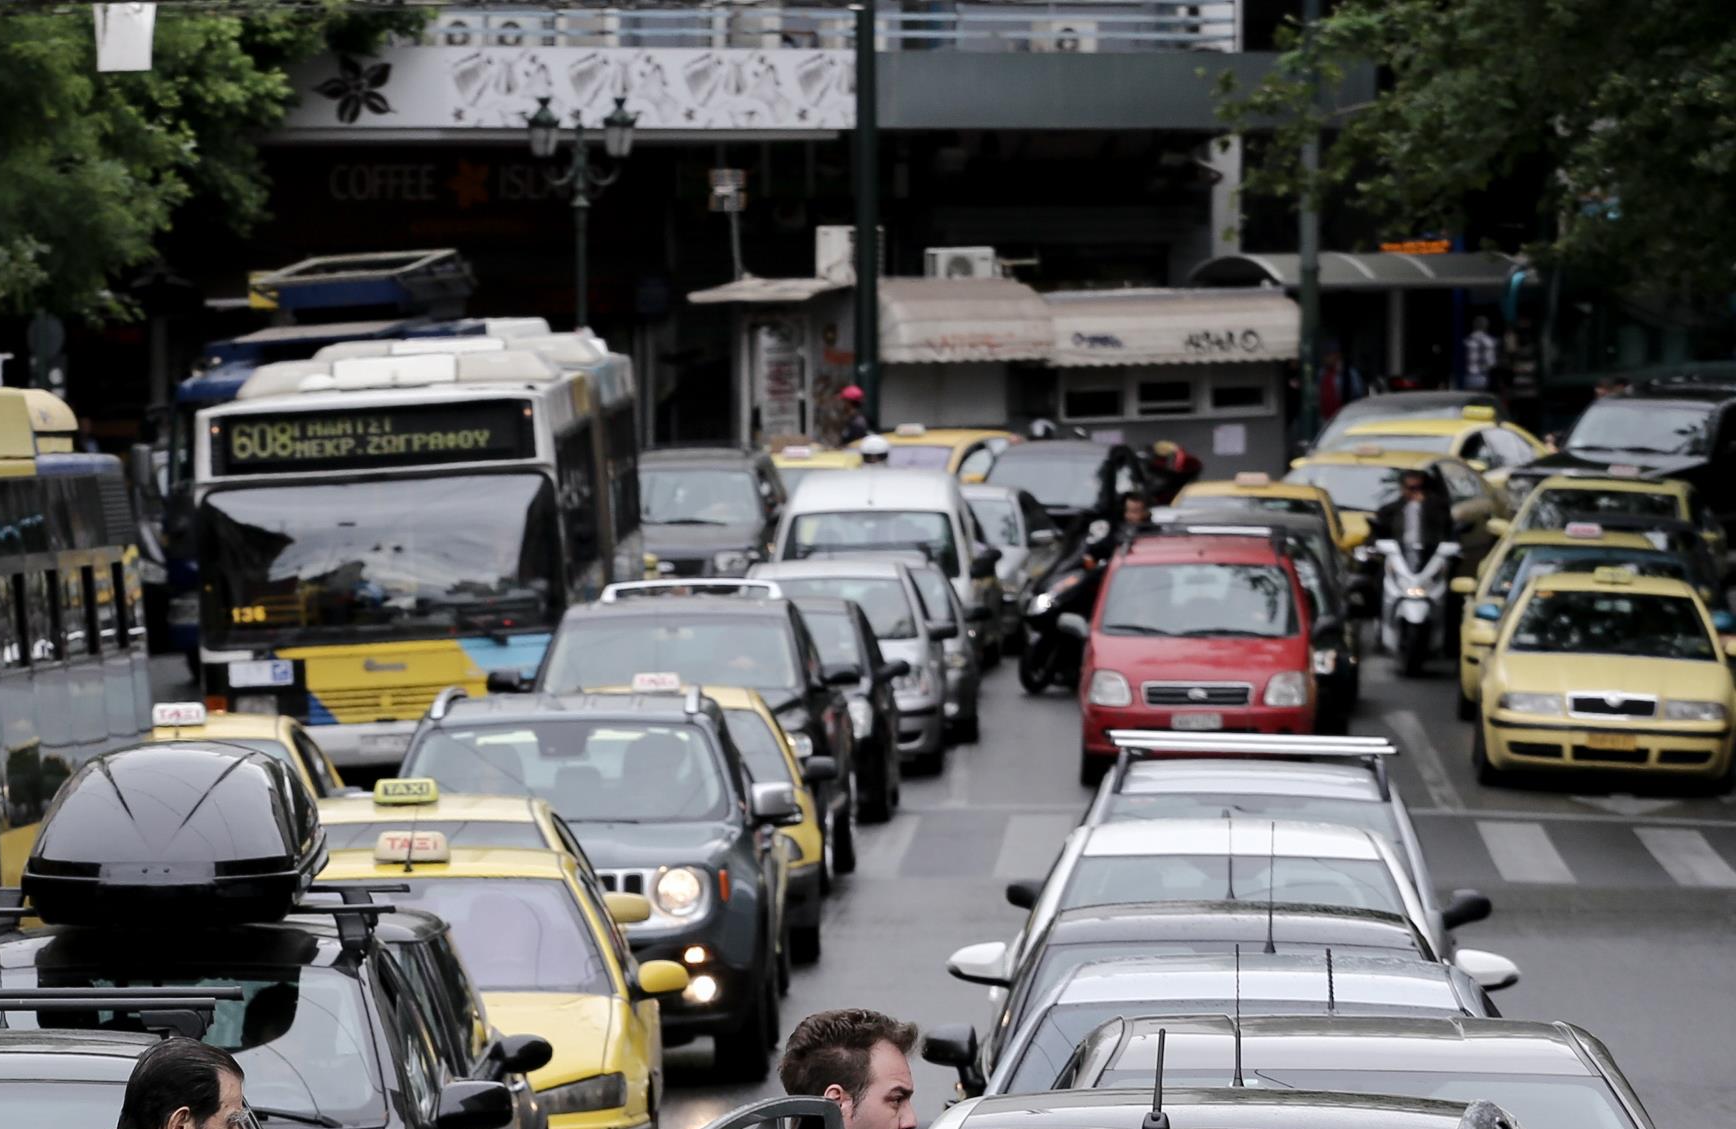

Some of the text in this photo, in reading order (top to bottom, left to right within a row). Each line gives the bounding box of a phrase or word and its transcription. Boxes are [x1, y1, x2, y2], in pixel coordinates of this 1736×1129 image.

[328, 163, 438, 200] COFFEE
[232, 422, 292, 459] 608
[383, 782, 430, 796] TAXI
